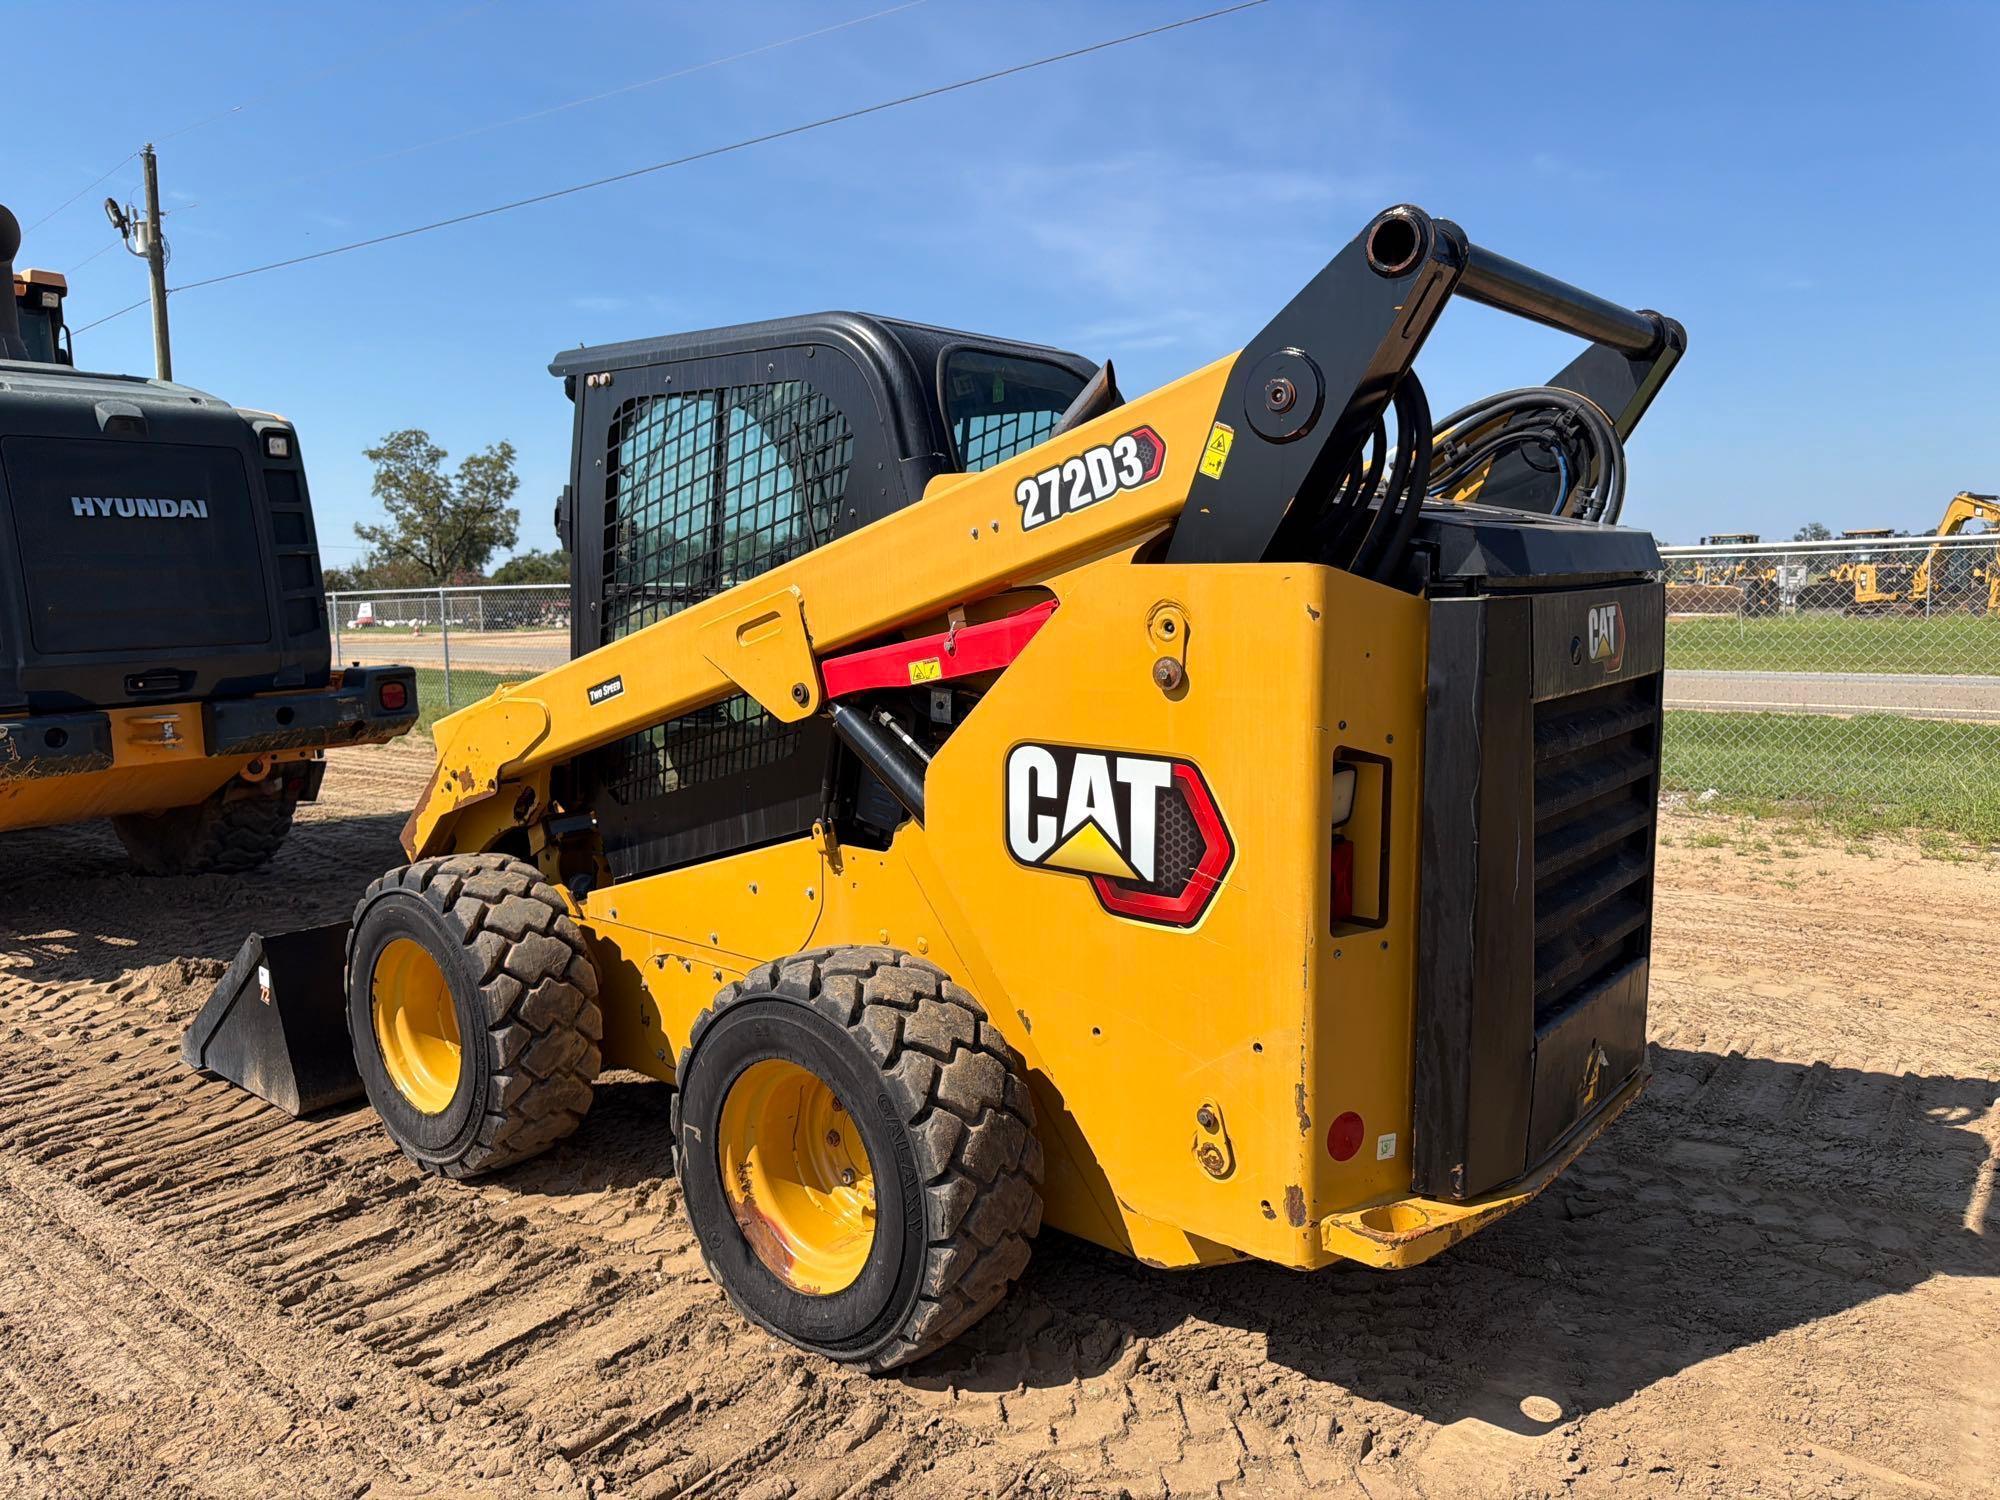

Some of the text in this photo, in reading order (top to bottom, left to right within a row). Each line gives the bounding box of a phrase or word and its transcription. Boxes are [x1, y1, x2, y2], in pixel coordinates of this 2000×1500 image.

[71, 496, 208, 518] HYUNDAI
[1016, 435, 1143, 528] 272D3
[1588, 605, 1616, 659] CAT
[1008, 745, 1171, 882] CAT
[877, 1093, 923, 1240] GALAXY
